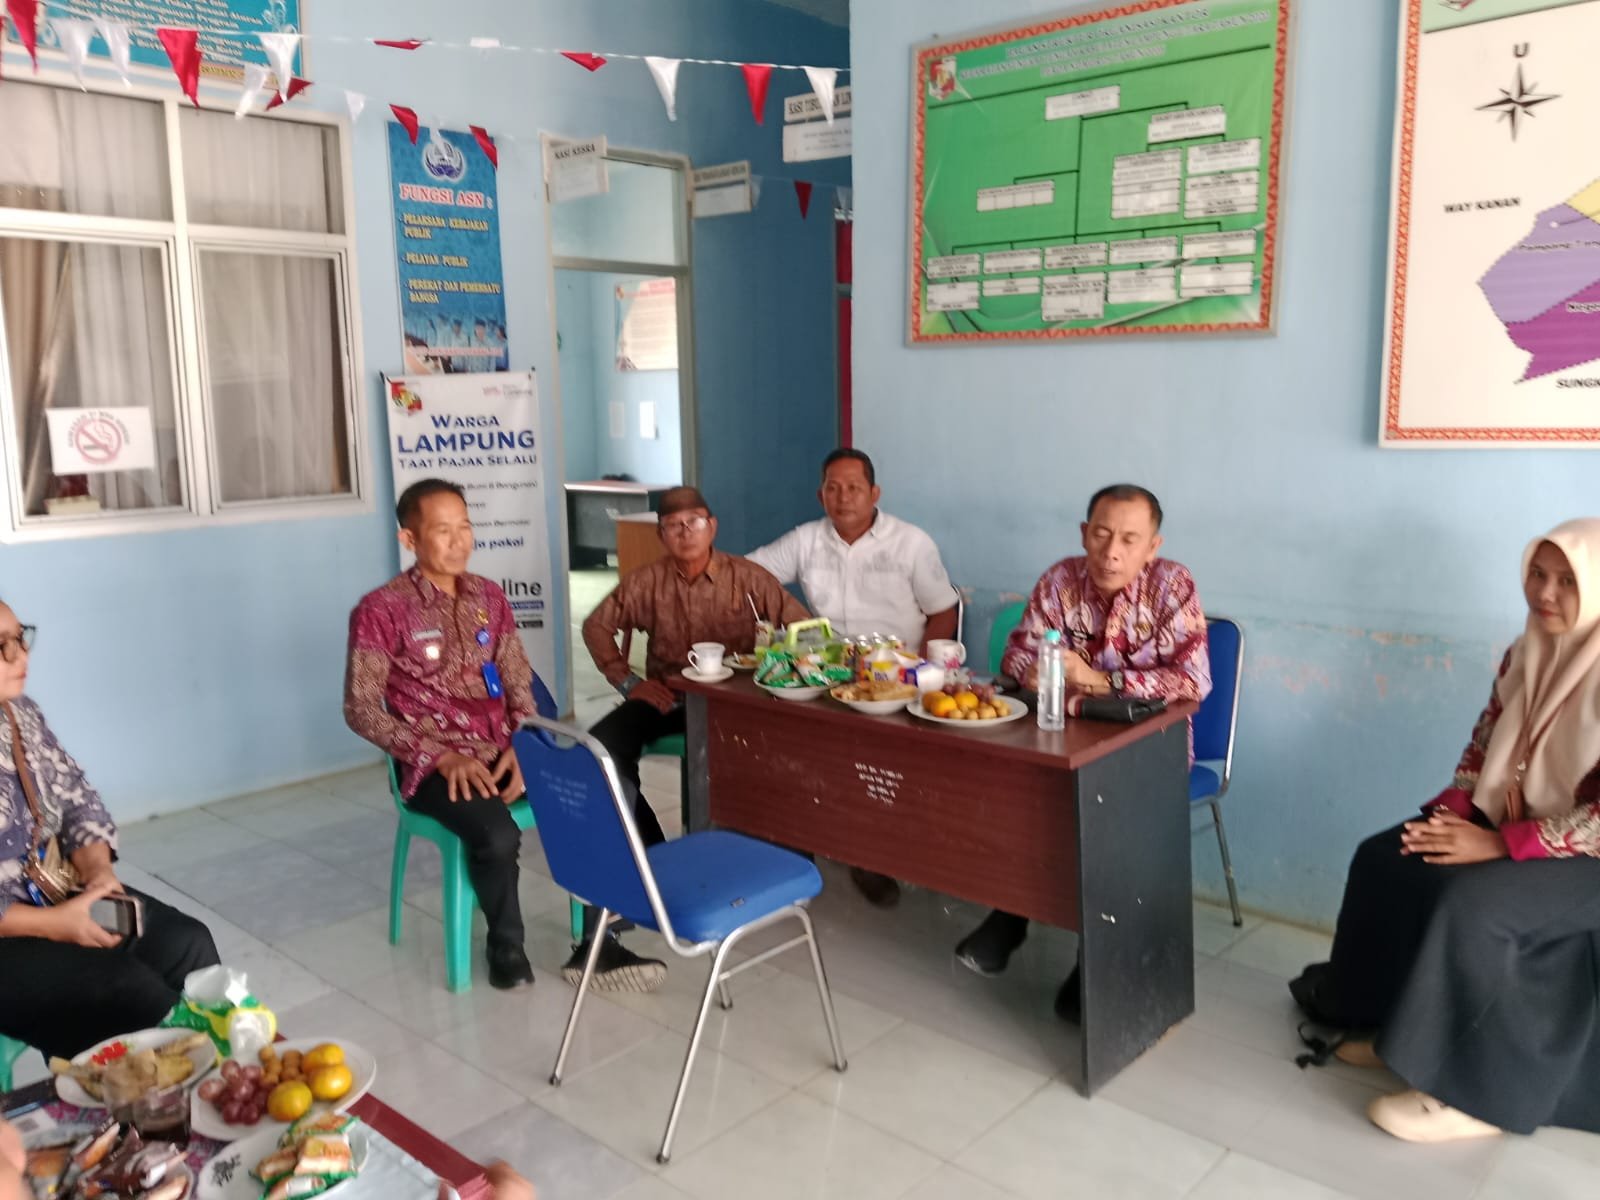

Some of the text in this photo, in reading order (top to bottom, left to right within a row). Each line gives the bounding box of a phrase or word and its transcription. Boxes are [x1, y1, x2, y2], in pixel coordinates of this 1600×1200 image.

[1513, 42, 1530, 59] U
[400, 183, 455, 206] FUNGSI
[456, 190, 485, 208] ASN
[1444, 196, 1521, 213] WAY KANAN
[404, 226, 432, 240] PUBLIK
[442, 255, 469, 269] PUBLIK
[430, 414, 500, 429] WARGA
[397, 430, 535, 453] LAMPUNG
[397, 454, 537, 470] TAAT PAJAK SELALU
[489, 536, 524, 550] pakai
[502, 578, 542, 596] line
